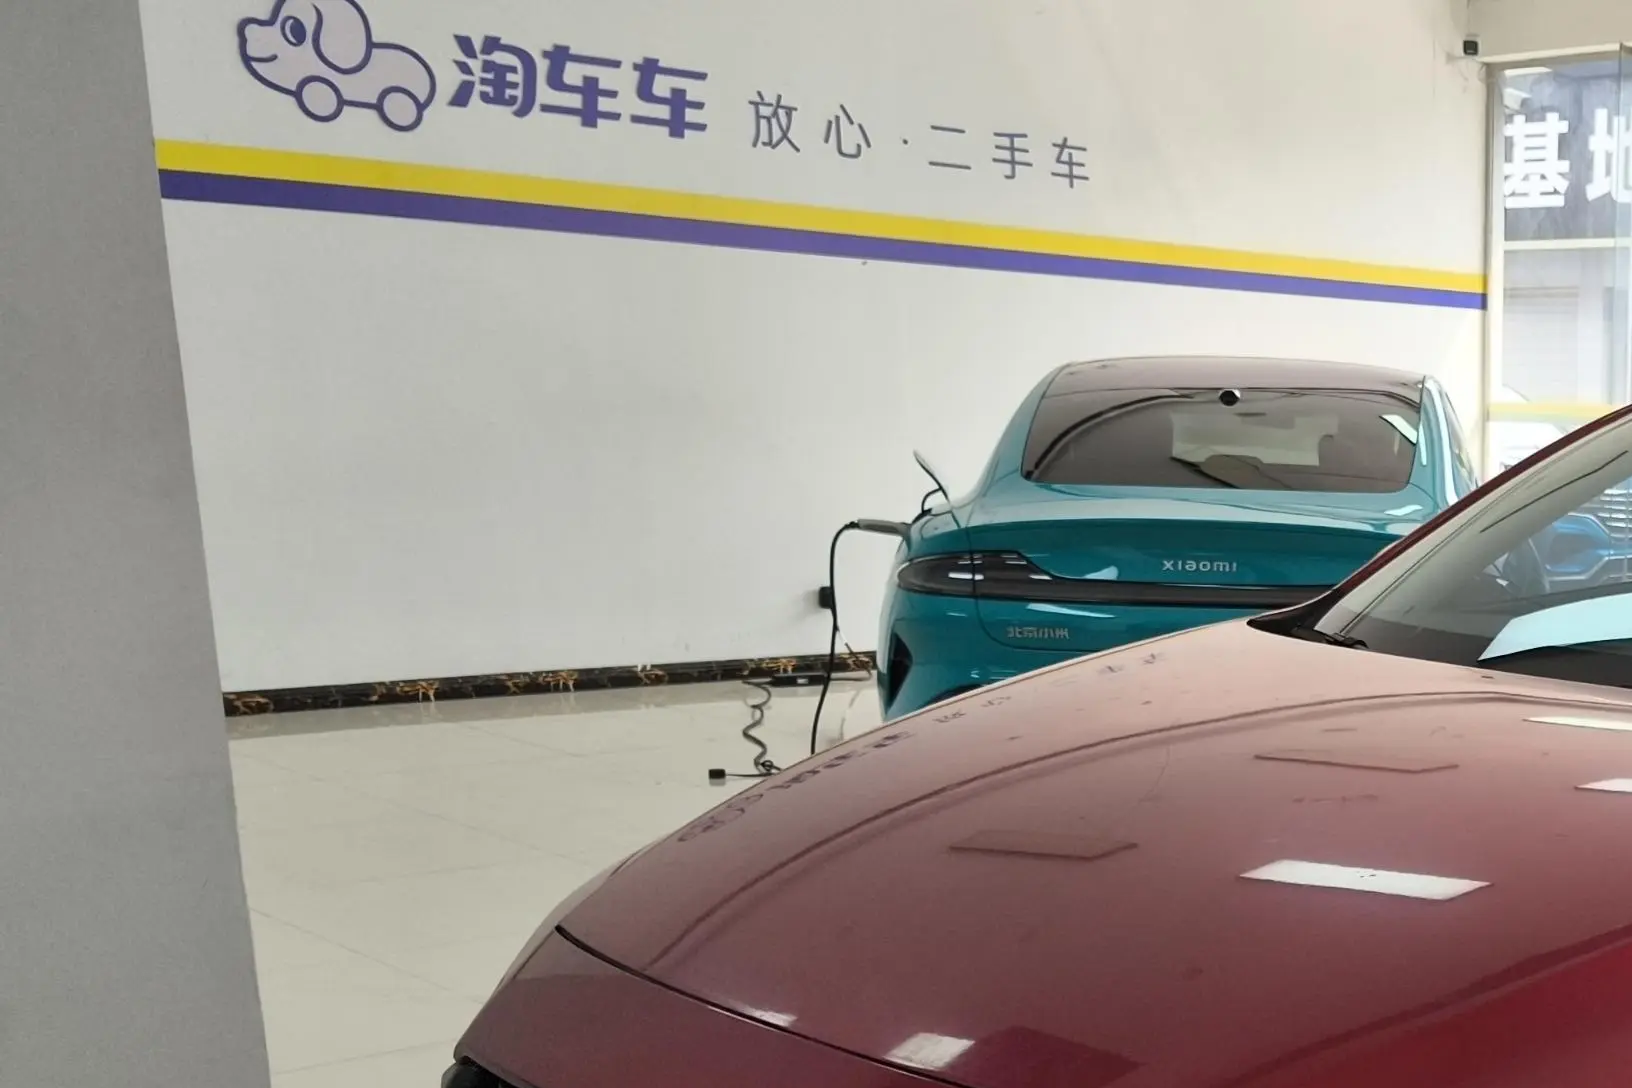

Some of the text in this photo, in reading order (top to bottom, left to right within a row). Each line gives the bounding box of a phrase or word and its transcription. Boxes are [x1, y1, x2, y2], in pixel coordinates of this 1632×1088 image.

[446, 34, 708, 139] 淘车车
[1162, 560, 1237, 572] xiaomi
